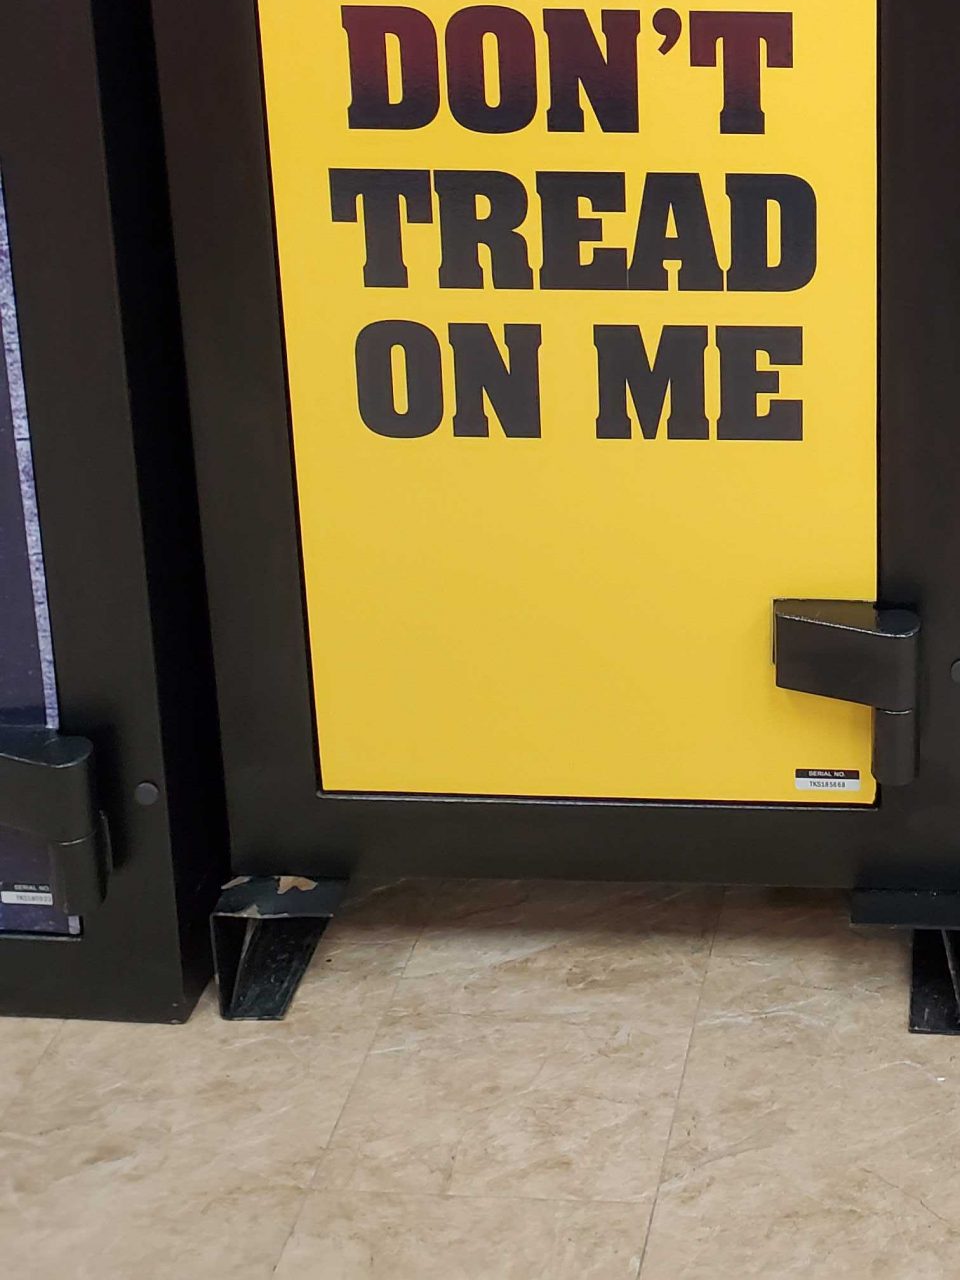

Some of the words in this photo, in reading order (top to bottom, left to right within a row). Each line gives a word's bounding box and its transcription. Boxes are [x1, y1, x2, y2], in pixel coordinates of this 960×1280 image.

[341, 4, 794, 135] DON'T
[328, 168, 818, 292] TREAD
[355, 319, 541, 439] ON
[593, 324, 804, 441] ME
